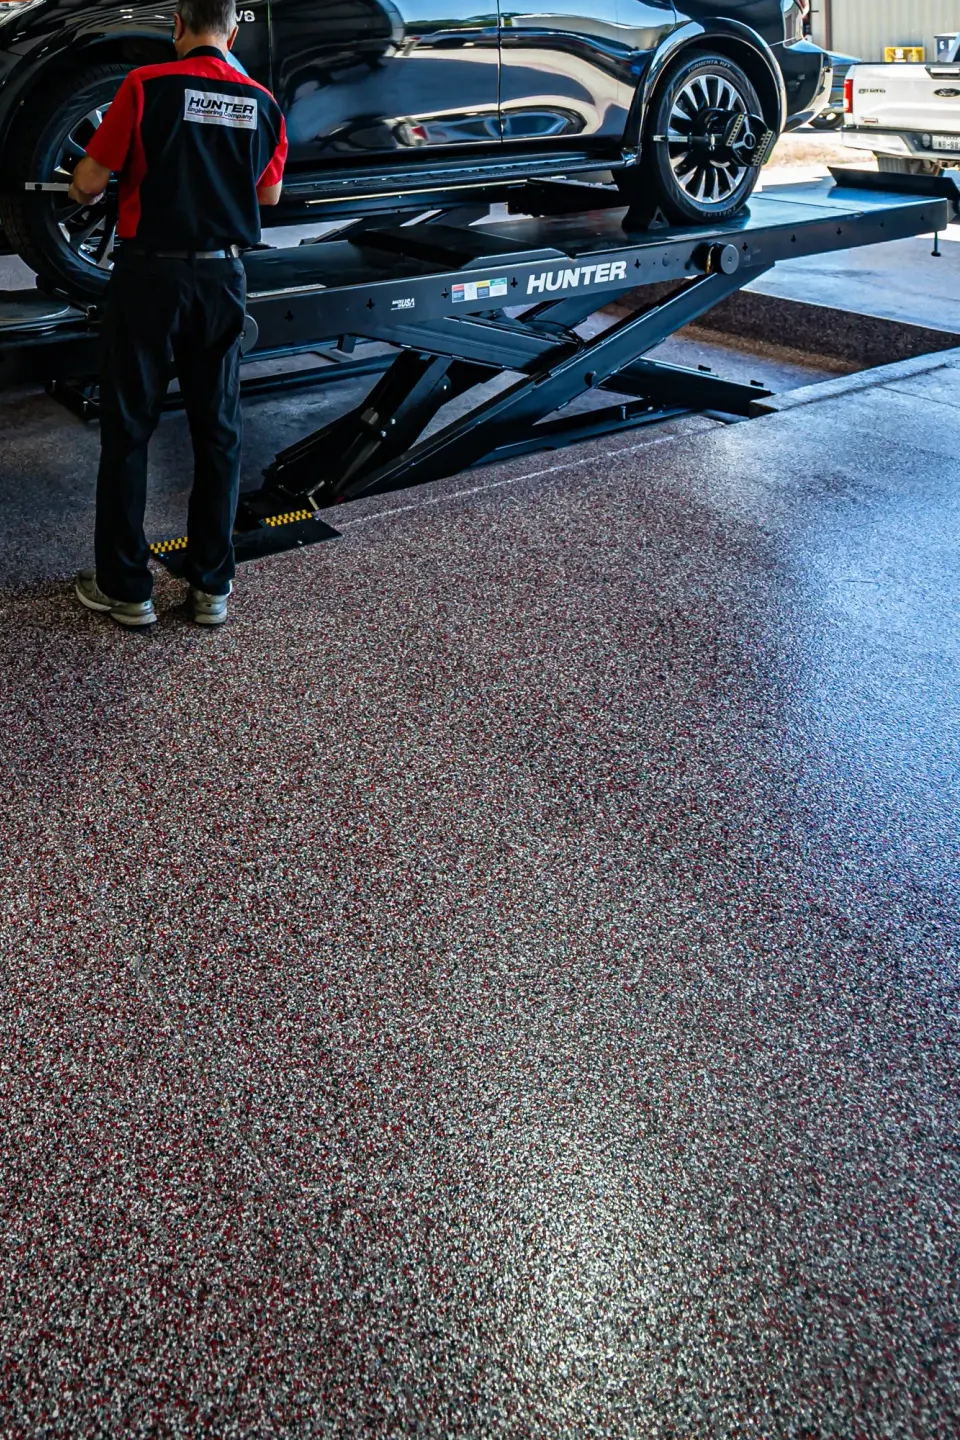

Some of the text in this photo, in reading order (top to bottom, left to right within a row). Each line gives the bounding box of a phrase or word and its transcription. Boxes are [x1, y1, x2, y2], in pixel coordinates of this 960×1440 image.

[187, 106, 223, 117] Engineering
[189, 97, 255, 114] HUNTER
[526, 261, 627, 295] HUNTER
[401, 298, 415, 308] USA
